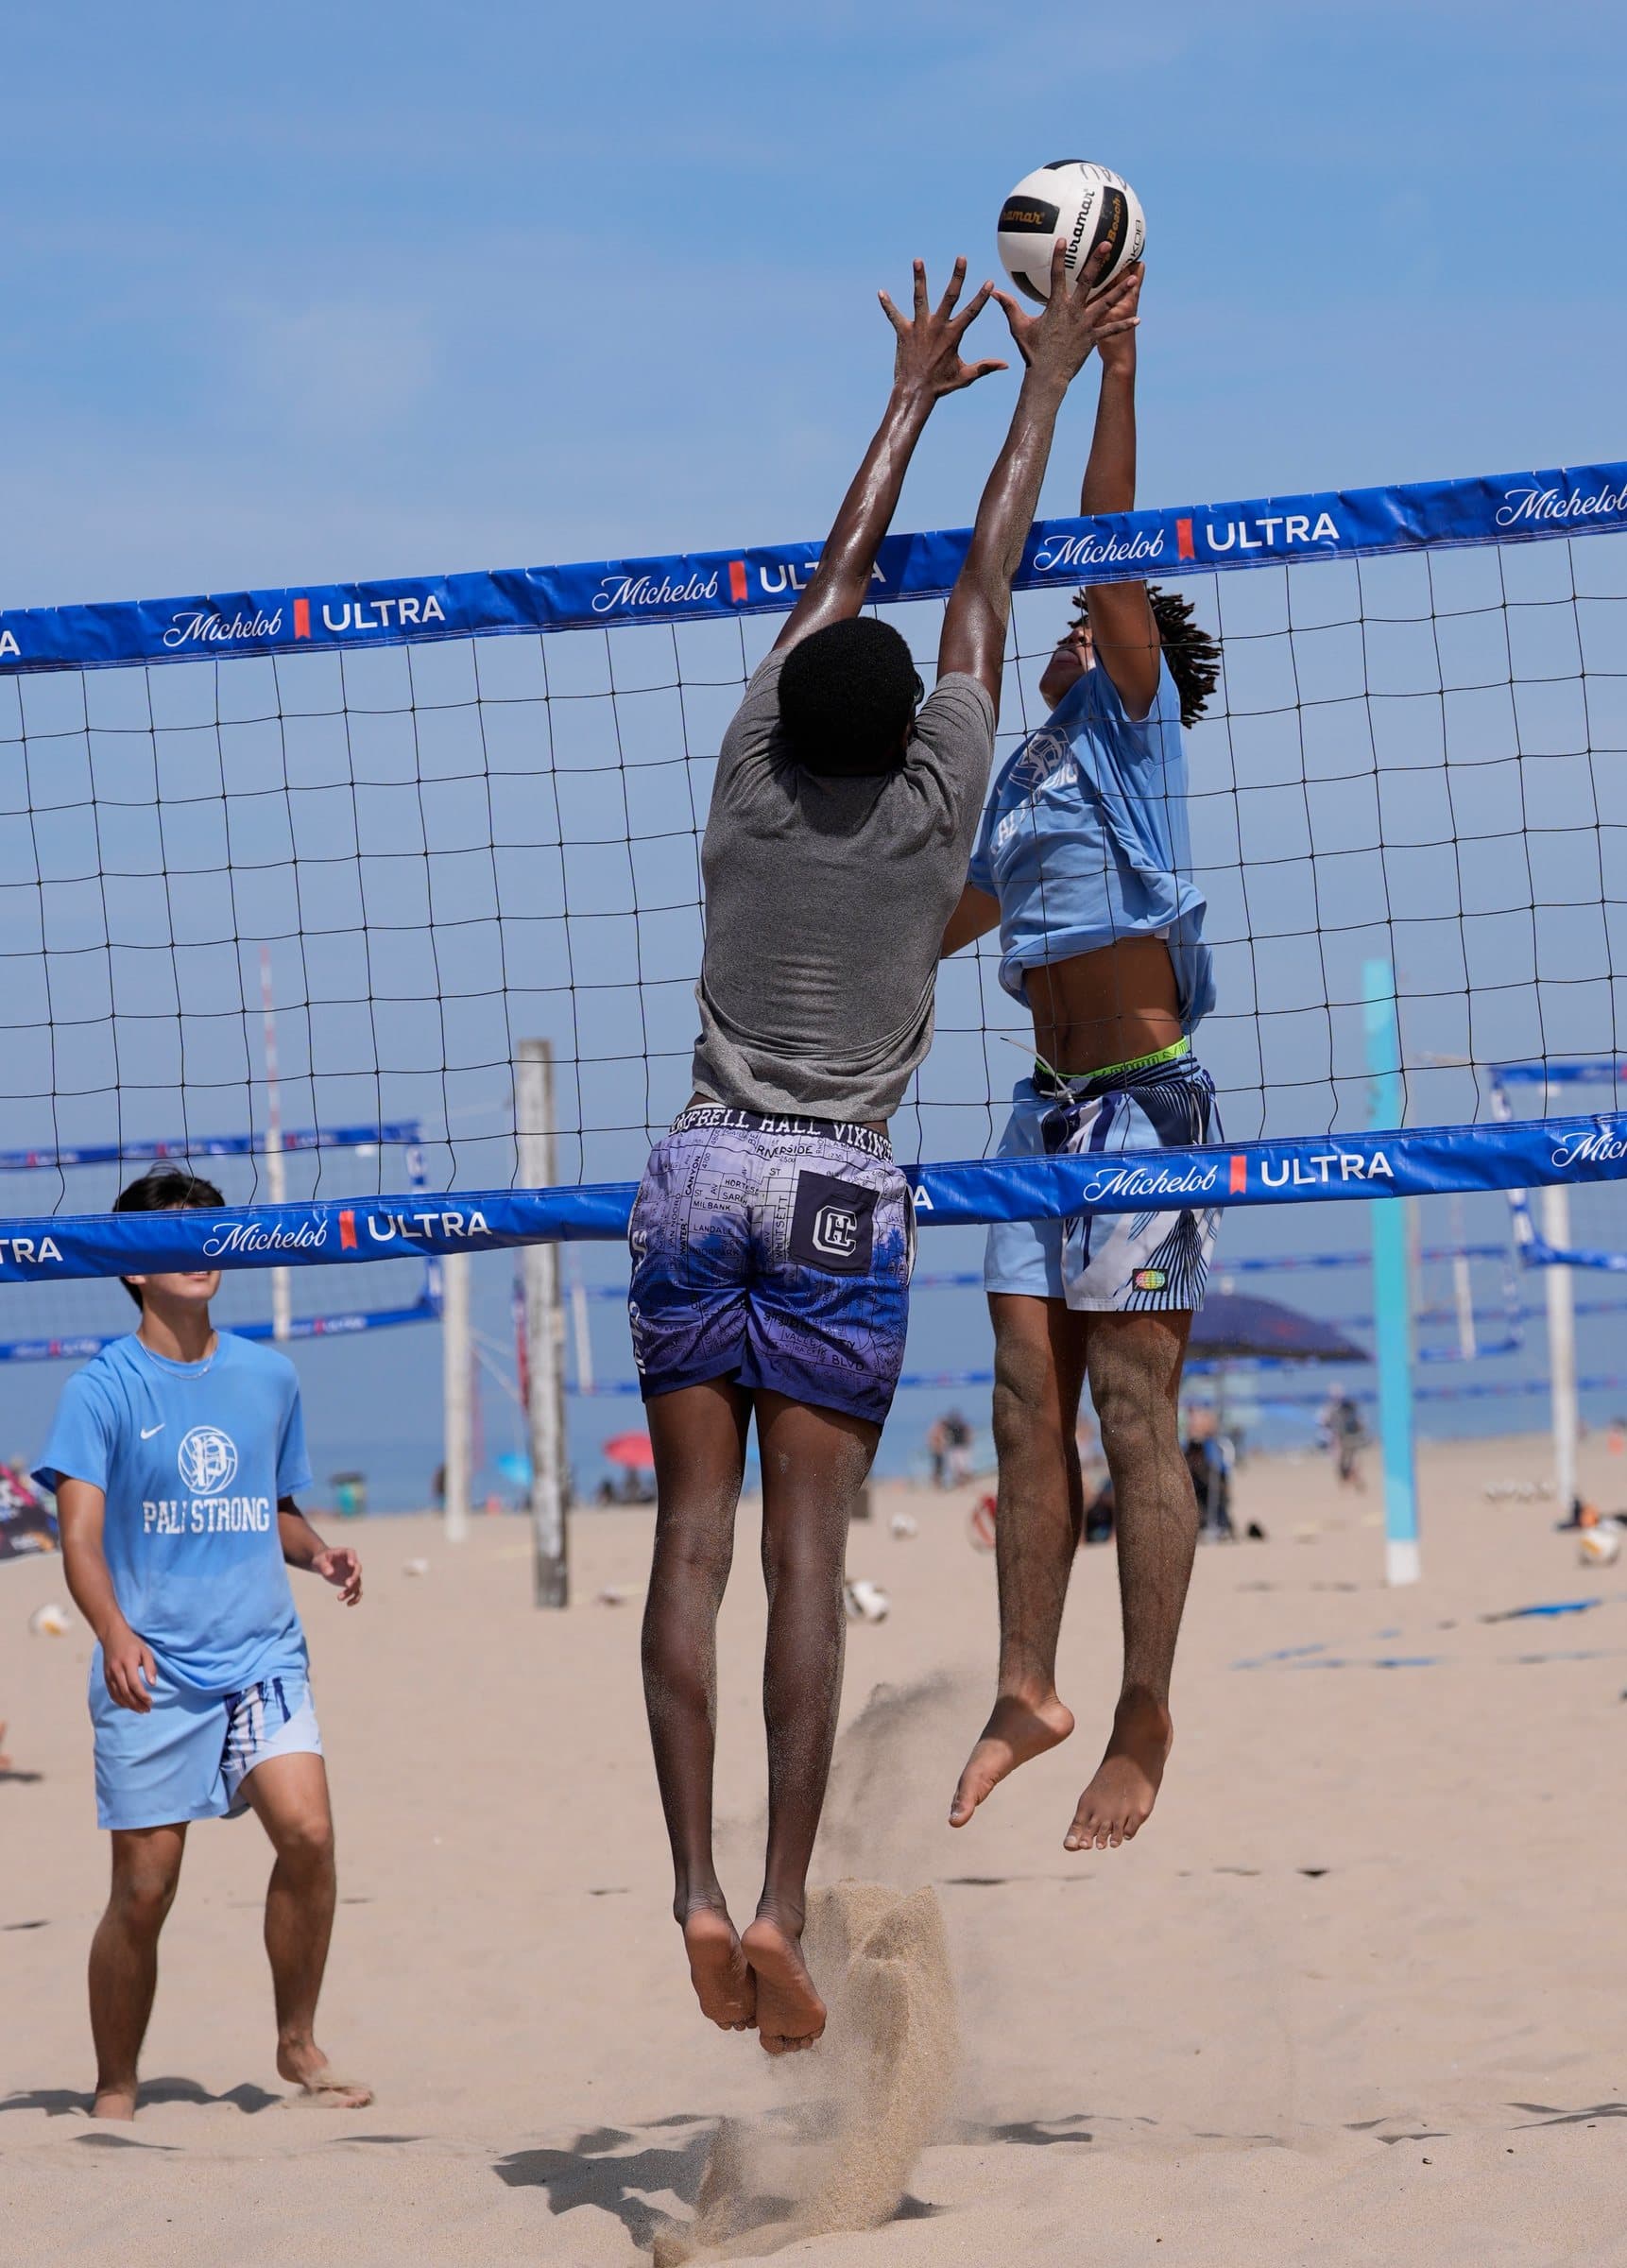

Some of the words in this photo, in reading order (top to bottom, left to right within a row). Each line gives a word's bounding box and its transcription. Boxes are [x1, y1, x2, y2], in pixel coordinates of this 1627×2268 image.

[1003, 210, 1043, 225] amar
[1065, 190, 1095, 269] Miramar
[1034, 529, 1165, 571] Michelob
[1207, 512, 1341, 551] ULTRA
[591, 571, 718, 612] Michelob
[760, 560, 886, 593] ULA
[163, 608, 283, 647] Michelob
[322, 595, 446, 631] ULTRA
[669, 1108, 749, 1136] AMPBELL
[759, 1113, 821, 1136] HALL
[685, 1156, 701, 1195] CANYON
[1083, 1165, 1217, 1201] Michelob
[1261, 1152, 1394, 1187] ULTRA
[693, 1200, 731, 1211] MILBANK
[202, 1221, 327, 1257] Michelob
[368, 1211, 492, 1242] ULTRA
[694, 1224, 735, 1235] LANDALE
[775, 1195, 788, 1259] WHITSETT
[832, 1355, 865, 1371] BLVD
[143, 1501, 187, 1534] PALI
[191, 1496, 270, 1534] STRONG
